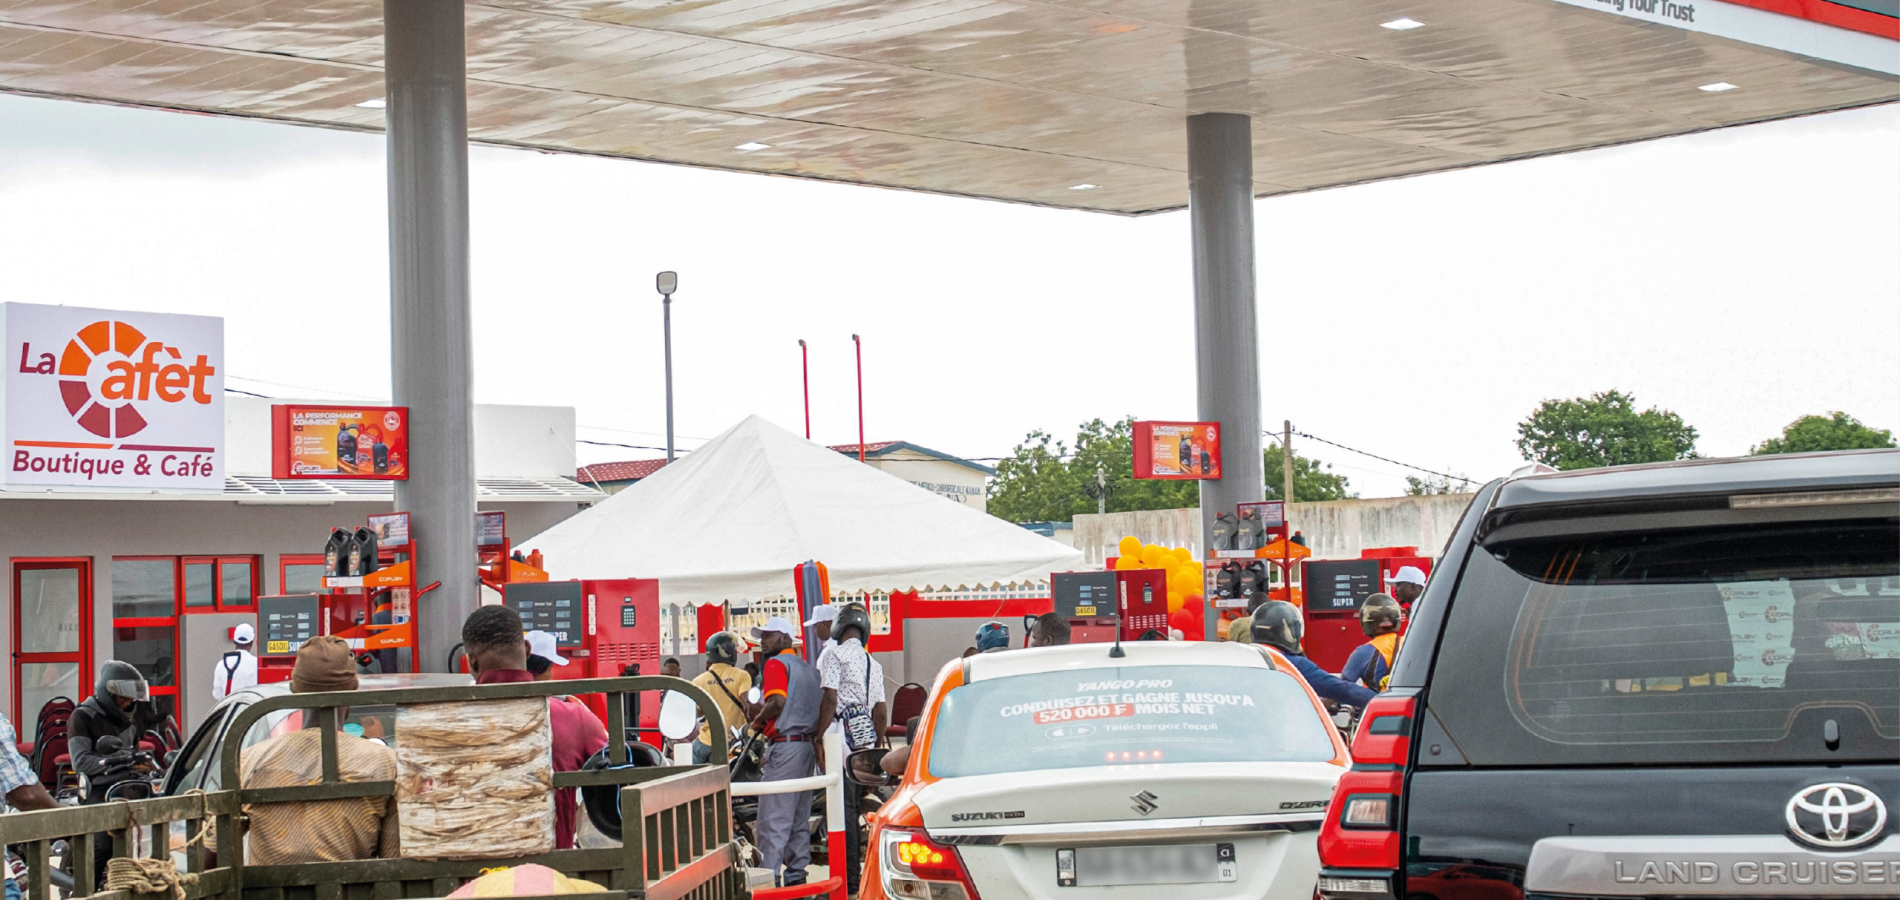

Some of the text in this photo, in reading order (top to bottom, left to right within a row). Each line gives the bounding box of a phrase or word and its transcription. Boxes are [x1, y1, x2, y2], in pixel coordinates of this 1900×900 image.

[1661, 0, 1695, 22] Trust
[19, 342, 56, 375] La
[12, 449, 214, 480] Boutique & Café
[1332, 598, 1354, 607] SUPER
[1076, 607, 1096, 615] GASOIL
[552, 631, 568, 642] PER
[268, 641, 304, 652] GASOIL SUP
[1077, 679, 1173, 692] YANGO PRO
[1000, 695, 1096, 718] CONDUISEZ
[1097, 694, 1120, 705] ET
[1122, 693, 1180, 705] GAGNE
[1039, 708, 1072, 724] 520
[1075, 705, 1111, 719] 000
[1136, 703, 1181, 715] MOIS
[1183, 703, 1216, 715] NET
[1103, 722, 1219, 733] Téléchargez l'appli
[951, 811, 1003, 822] SUZUKI
[1220, 849, 1230, 857] CI
[1222, 868, 1232, 877] 01
[1614, 860, 1719, 884] LAND
